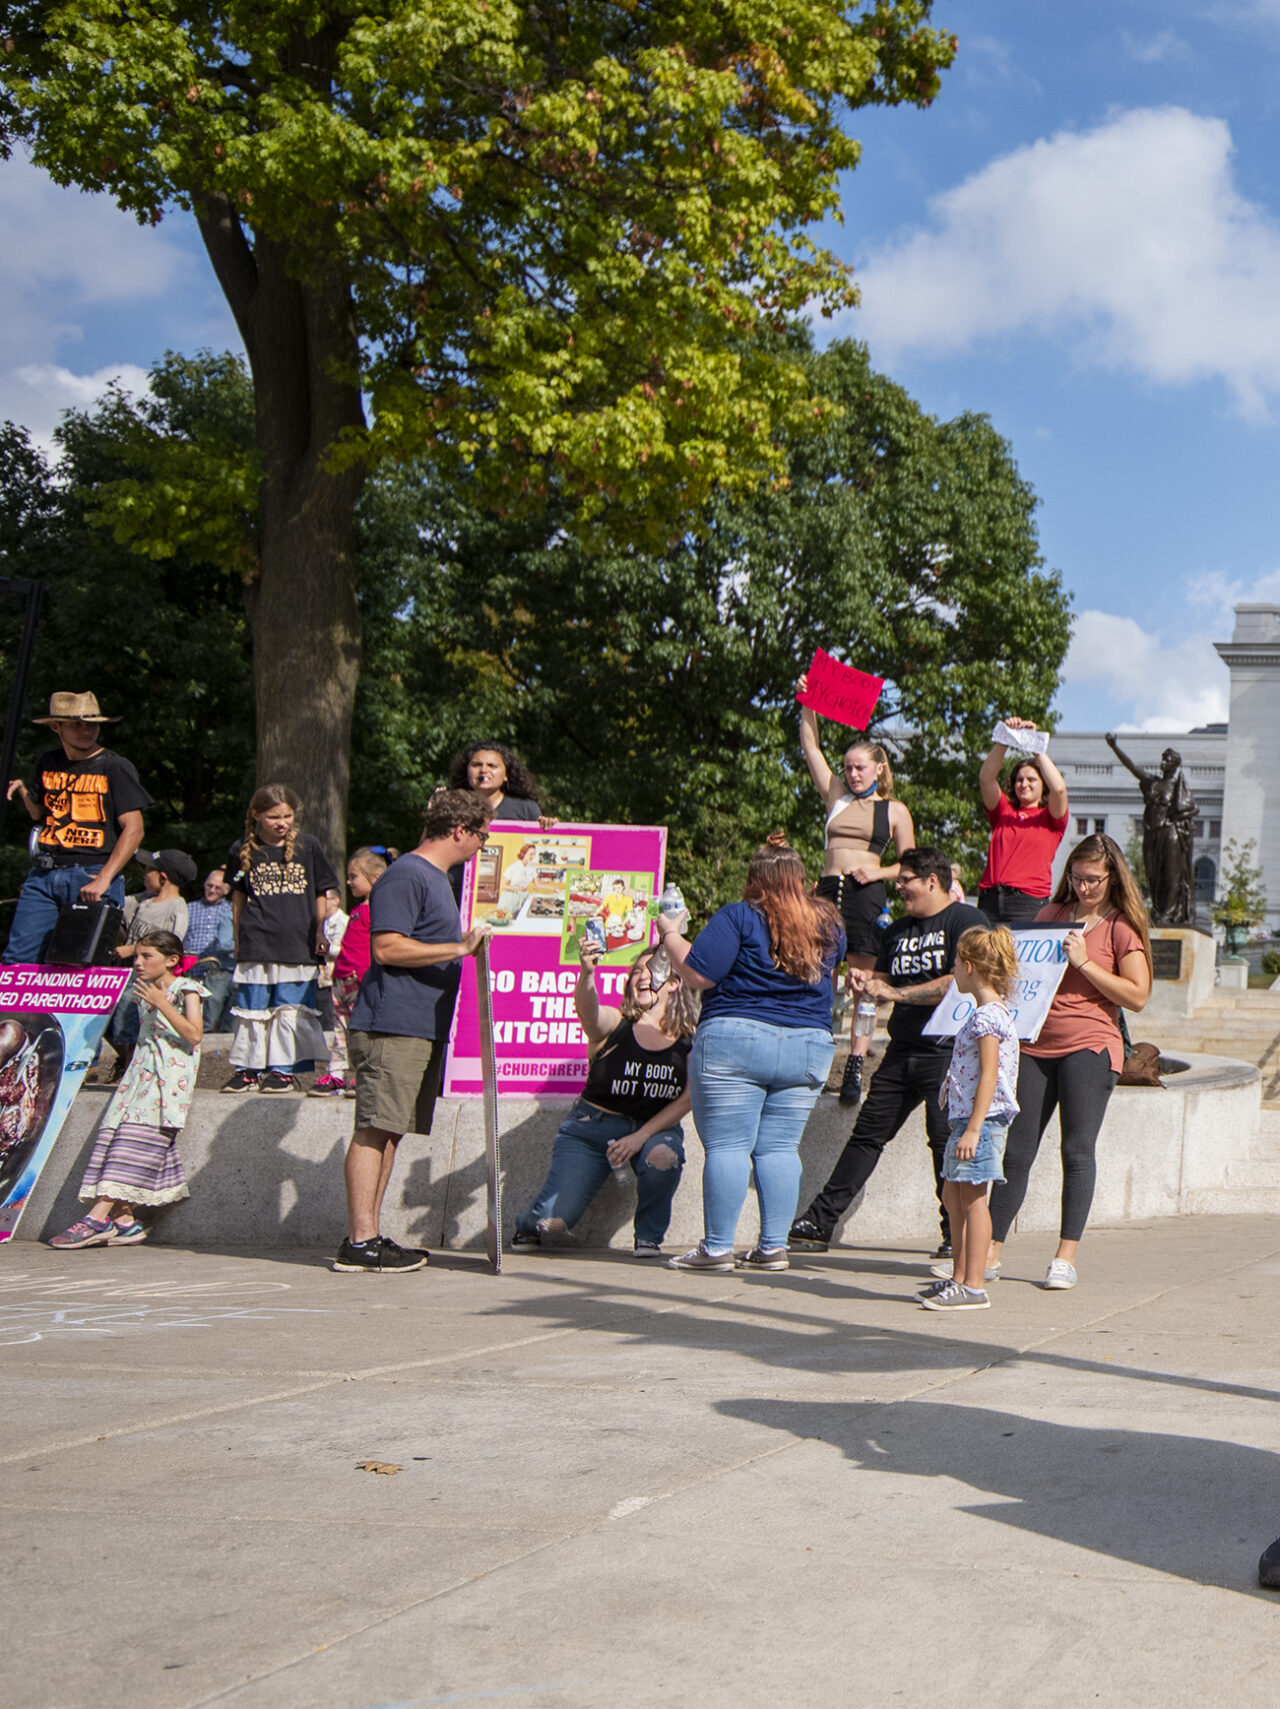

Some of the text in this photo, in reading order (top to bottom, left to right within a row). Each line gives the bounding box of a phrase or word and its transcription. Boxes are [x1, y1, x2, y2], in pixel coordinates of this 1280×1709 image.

[815, 653, 877, 694] MY BODY
[66, 828, 98, 837] NOT
[15, 972, 85, 987] STANDING
[87, 974, 123, 989] WITH
[521, 971, 580, 994] BAC
[600, 973, 629, 994] TO
[0, 992, 112, 1009] ED PARENTHOOD
[530, 997, 577, 1019] THE
[496, 1063, 589, 1077] #CHURCHREPE
[624, 1061, 677, 1084] MY BODY,
[611, 1079, 681, 1099] NOT YOURS
